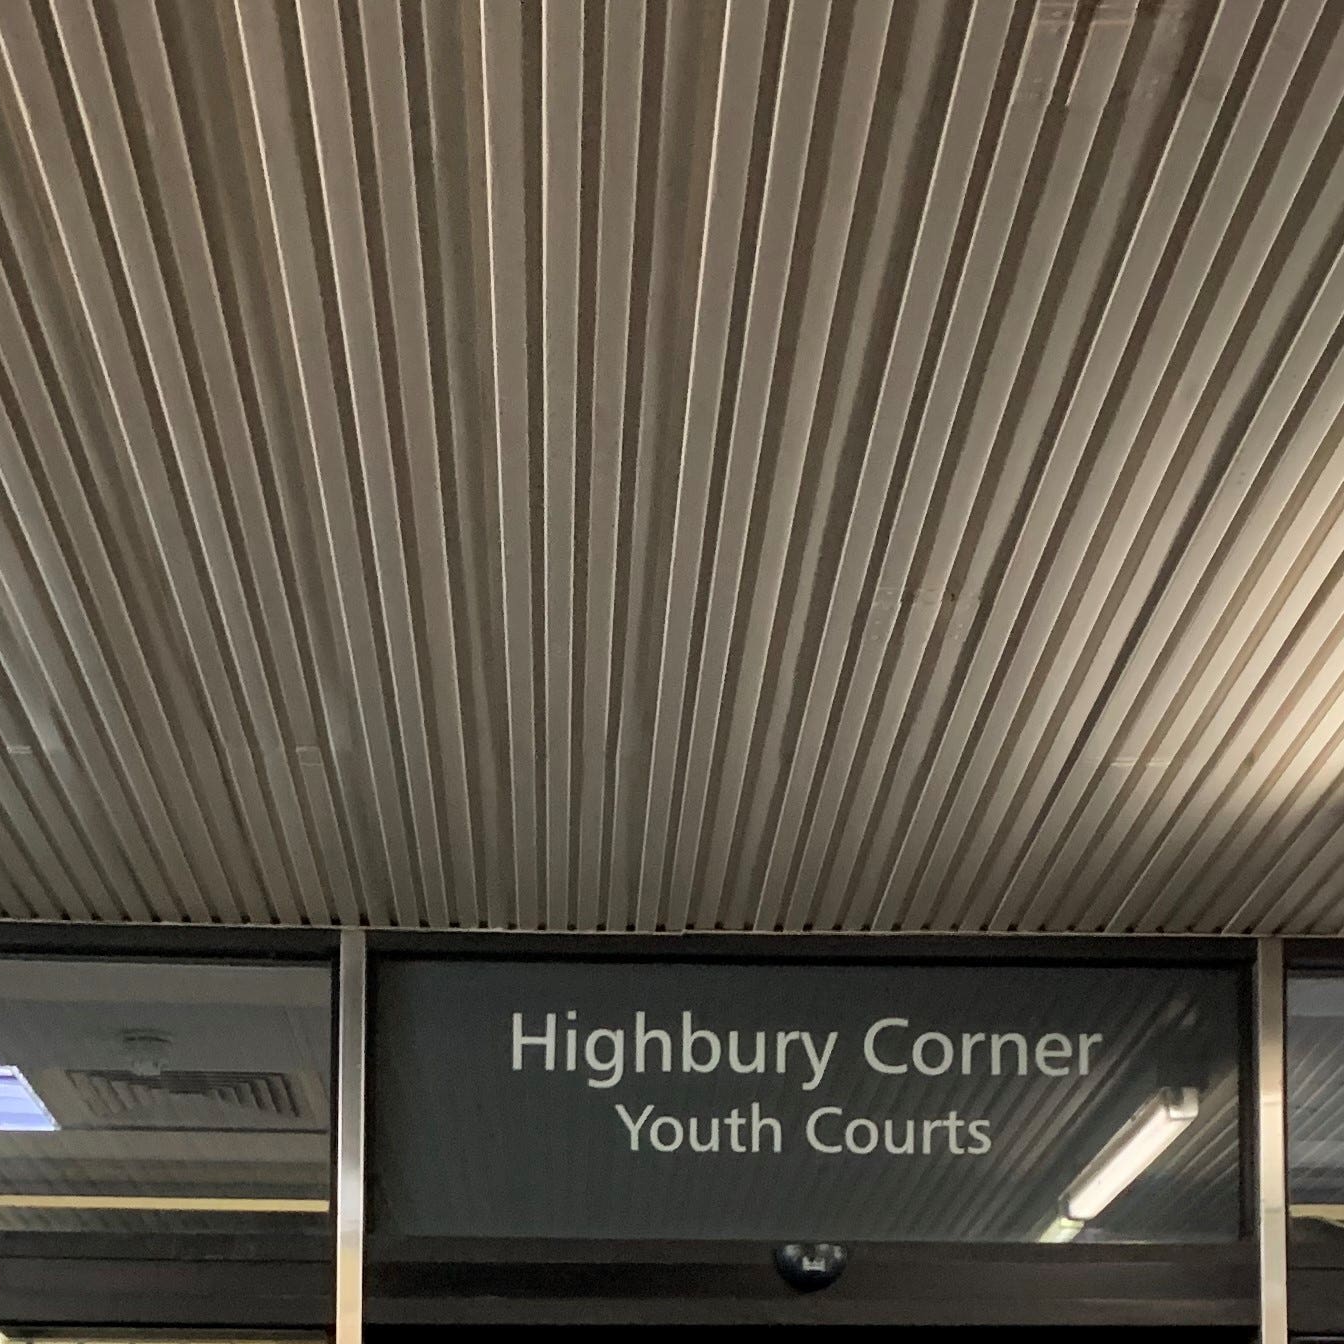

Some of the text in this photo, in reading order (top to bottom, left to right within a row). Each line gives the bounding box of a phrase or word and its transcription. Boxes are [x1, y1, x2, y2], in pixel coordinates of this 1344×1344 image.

[511, 1010, 1103, 1091] Highbury Corner
[614, 1102, 992, 1156] Youth Courts
